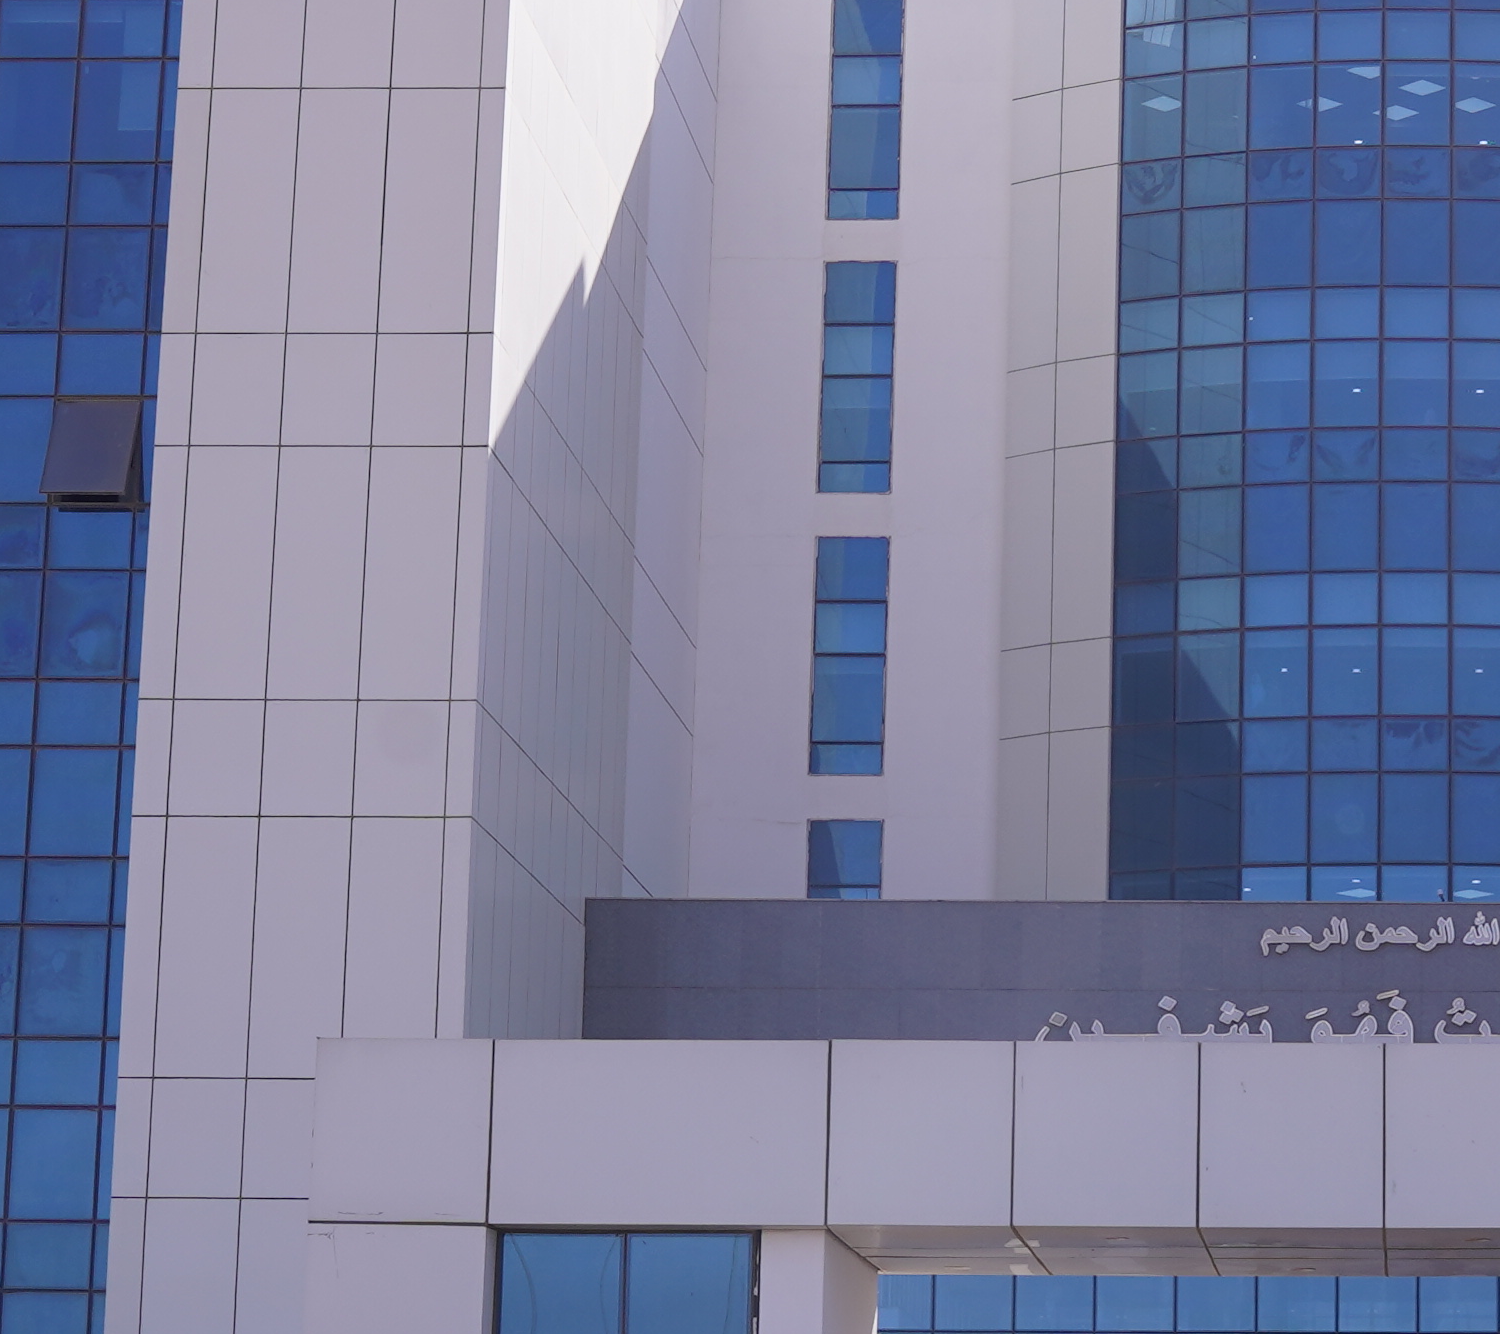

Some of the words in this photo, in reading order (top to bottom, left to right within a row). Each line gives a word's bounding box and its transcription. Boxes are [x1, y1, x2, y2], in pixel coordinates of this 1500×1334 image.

[1260, 915, 1349, 957] الرحيم
[1355, 916, 1455, 952] الرحمن
[1462, 911, 1500, 946] الله
